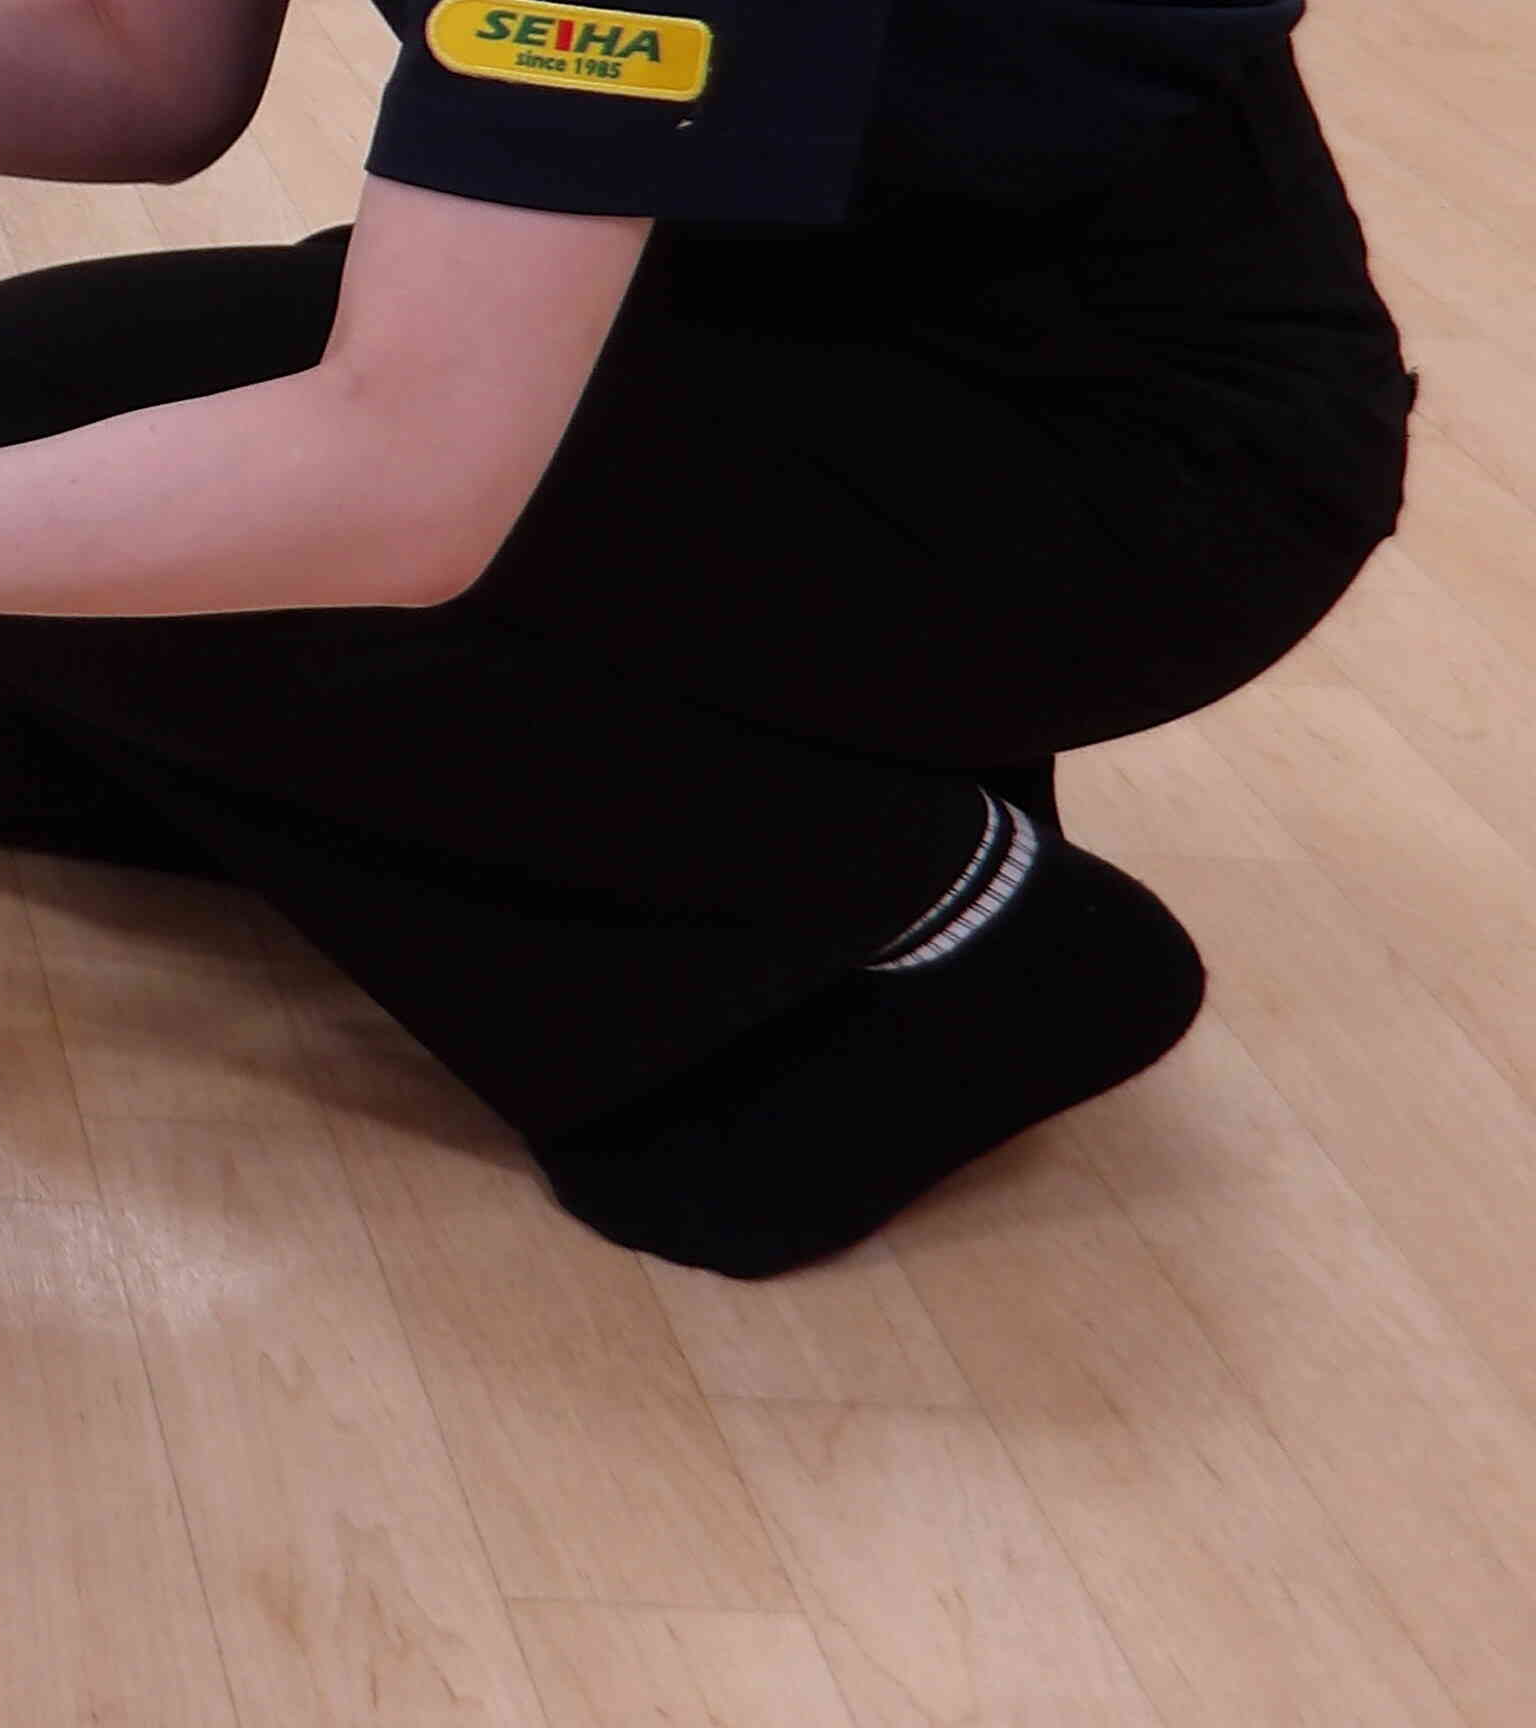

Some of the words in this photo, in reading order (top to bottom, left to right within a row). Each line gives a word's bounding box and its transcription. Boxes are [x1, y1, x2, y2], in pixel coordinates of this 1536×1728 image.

[475, 10, 661, 63] SEIHA
[515, 49, 567, 73] since
[575, 57, 623, 79] 1985
